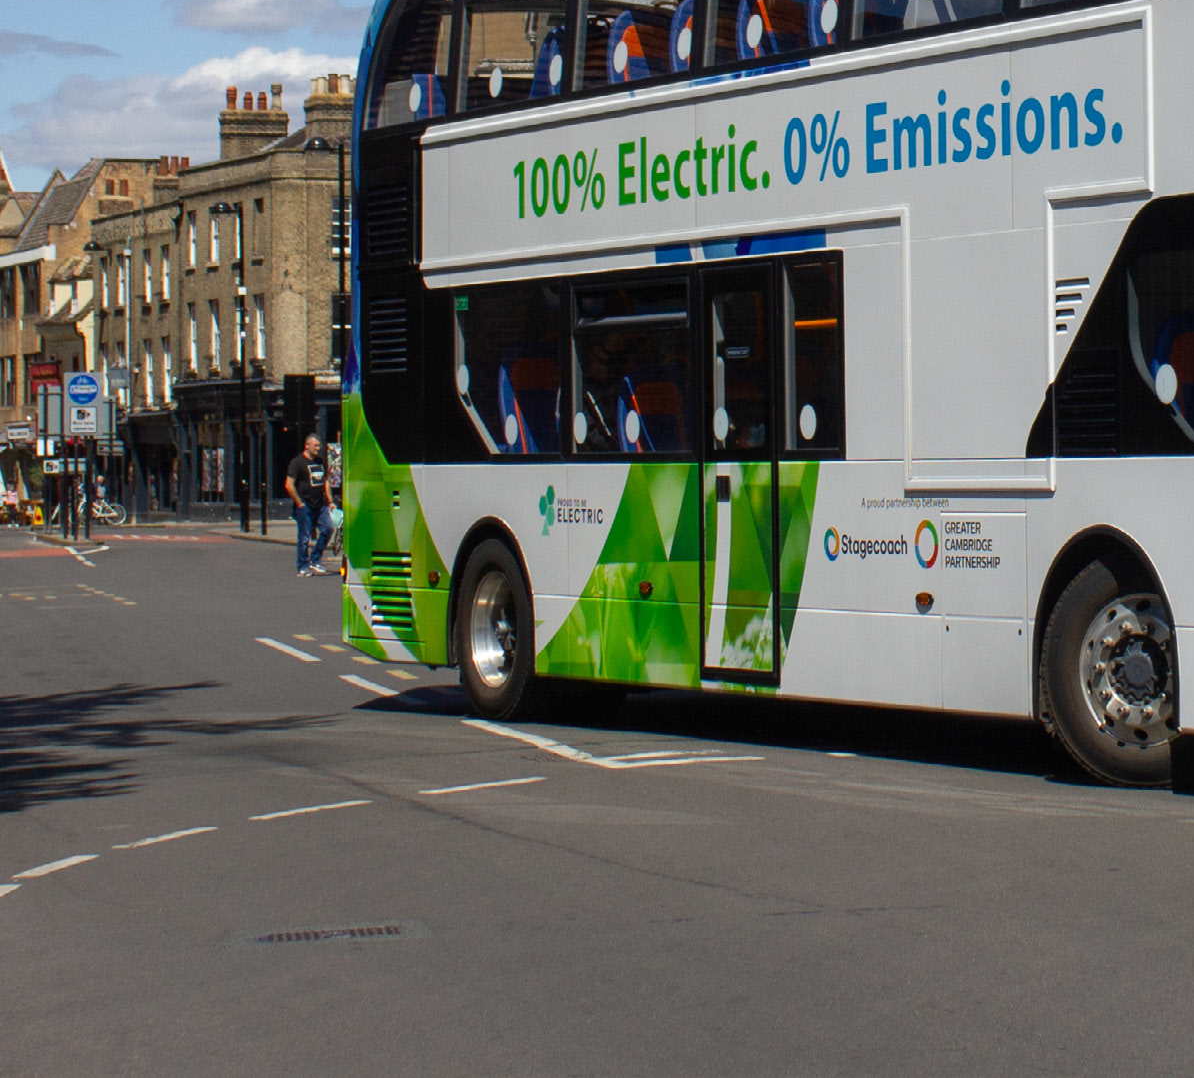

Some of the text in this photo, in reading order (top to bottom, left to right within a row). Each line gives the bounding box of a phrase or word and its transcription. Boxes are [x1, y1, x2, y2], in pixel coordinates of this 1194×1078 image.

[513, 79, 1123, 219] 100% Electric. 0% Emissions.
[557, 498, 572, 507] PROUD
[573, 499, 580, 507] TO
[861, 498, 949, 510] A proud partnership between
[557, 508, 604, 524] ELECTRIC
[945, 522, 981, 534] GREATER
[841, 535, 908, 559] Stagecoach
[945, 539, 992, 551] CAMBRIDGE
[945, 556, 1000, 569] PARTNERSHIP
